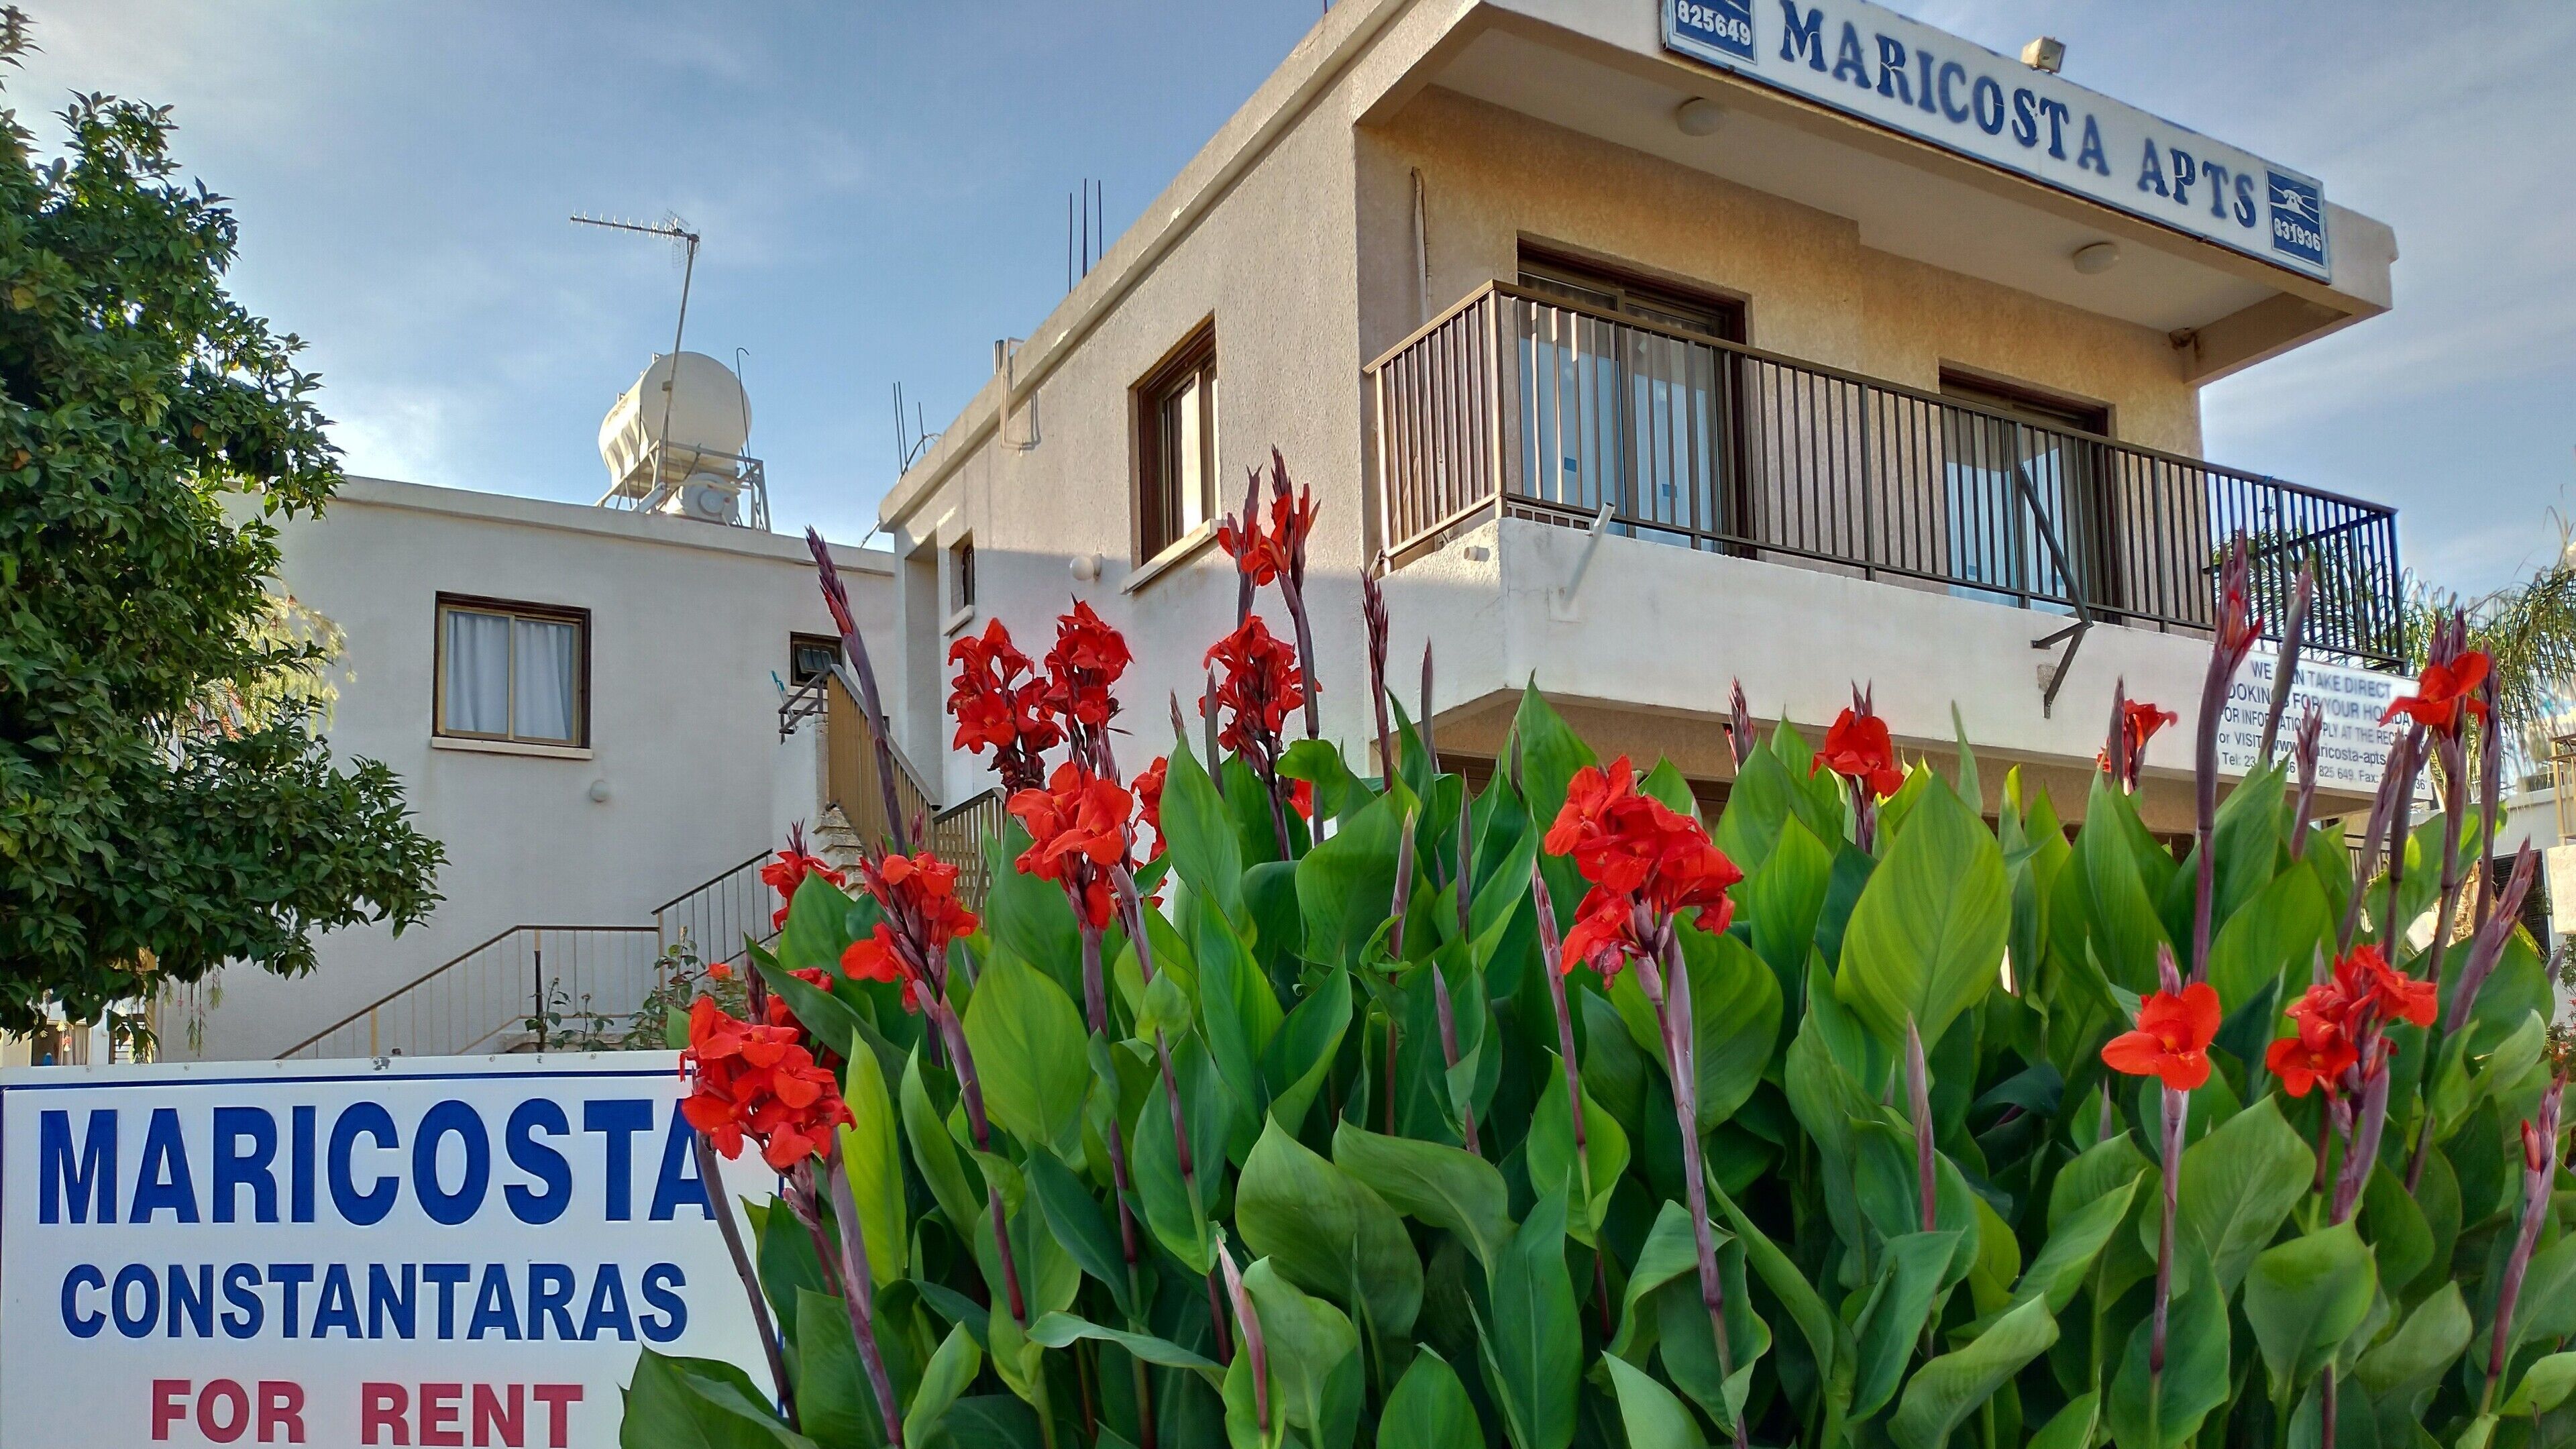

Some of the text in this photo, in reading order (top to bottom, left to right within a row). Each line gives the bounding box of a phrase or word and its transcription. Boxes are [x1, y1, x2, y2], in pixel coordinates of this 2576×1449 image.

[1678, 1, 1752, 46] 825649
[1779, 0, 2257, 228] MARICOSTA APTS
[2273, 217, 2322, 252] 831936
[2251, 660, 2273, 680] WE
[2308, 671, 2341, 692] TAKE
[2345, 677, 2392, 699] DIRECT
[2221, 706, 2239, 724] OR
[2342, 725, 2352, 741] AT
[2355, 727, 2374, 745] THE
[2324, 696, 2359, 719] YOUR
[2218, 733, 2229, 744] or
[2234, 731, 2263, 748] VISIT
[2222, 752, 2241, 766] Tel:
[2318, 765, 2334, 778] 825
[2359, 769, 2379, 783] Fax:
[39, 1099, 718, 1226] MARICOSTA
[60, 1263, 688, 1341] CONSTANTARAS
[152, 1379, 584, 1448] FOR RENT
